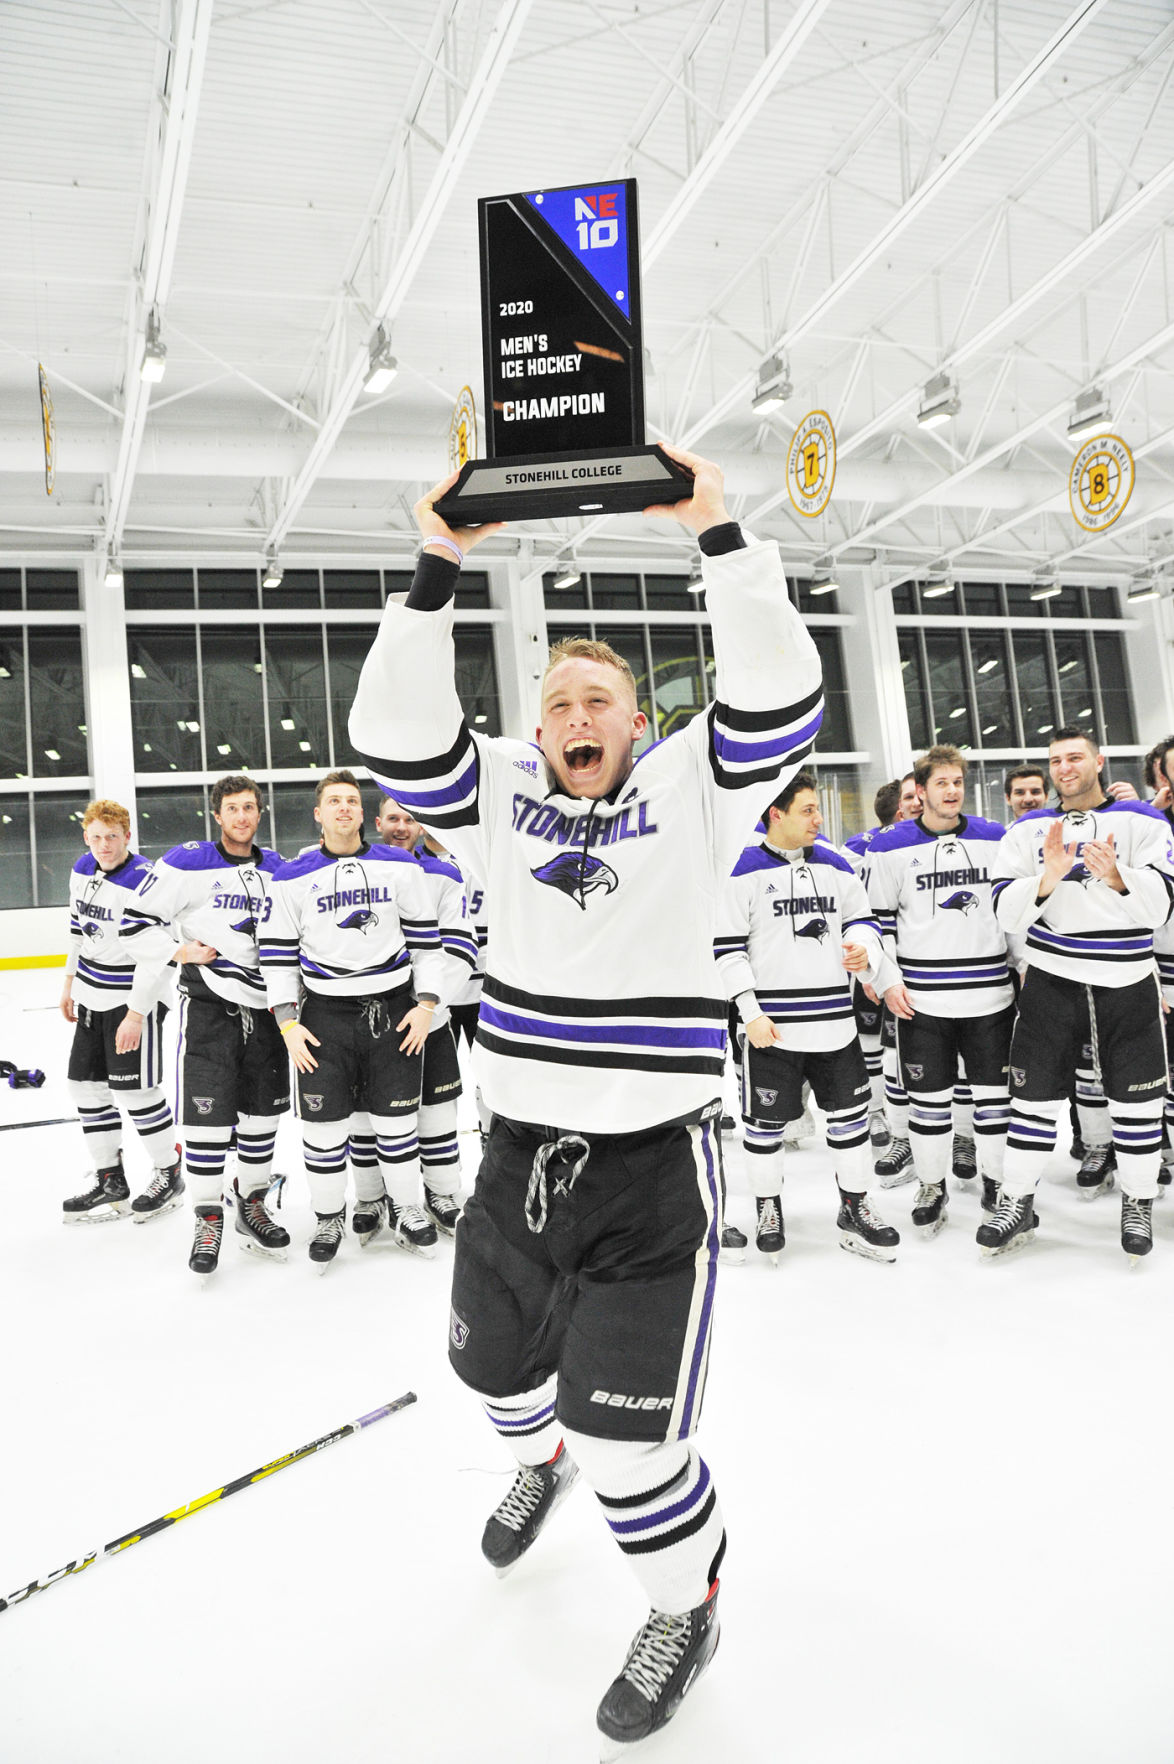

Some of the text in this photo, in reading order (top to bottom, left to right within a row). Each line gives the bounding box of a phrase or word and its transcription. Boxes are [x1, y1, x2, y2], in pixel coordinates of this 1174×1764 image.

[574, 192, 619, 221] NE
[576, 218, 619, 250] 10
[499, 300, 534, 317] 2020
[500, 334, 548, 356] MEN'S
[501, 353, 582, 379] ICE HOCKEY
[502, 392, 605, 422] CHAMPION
[505, 464, 622, 485] STONEHILL COLLEGE
[807, 452, 815, 476] 7
[1093, 473, 1105, 495] 8
[512, 760, 539, 779] adidas
[916, 867, 991, 892] STONEHILL
[316, 886, 393, 914] STONEHILL
[589, 1389, 674, 1411] BAUER
